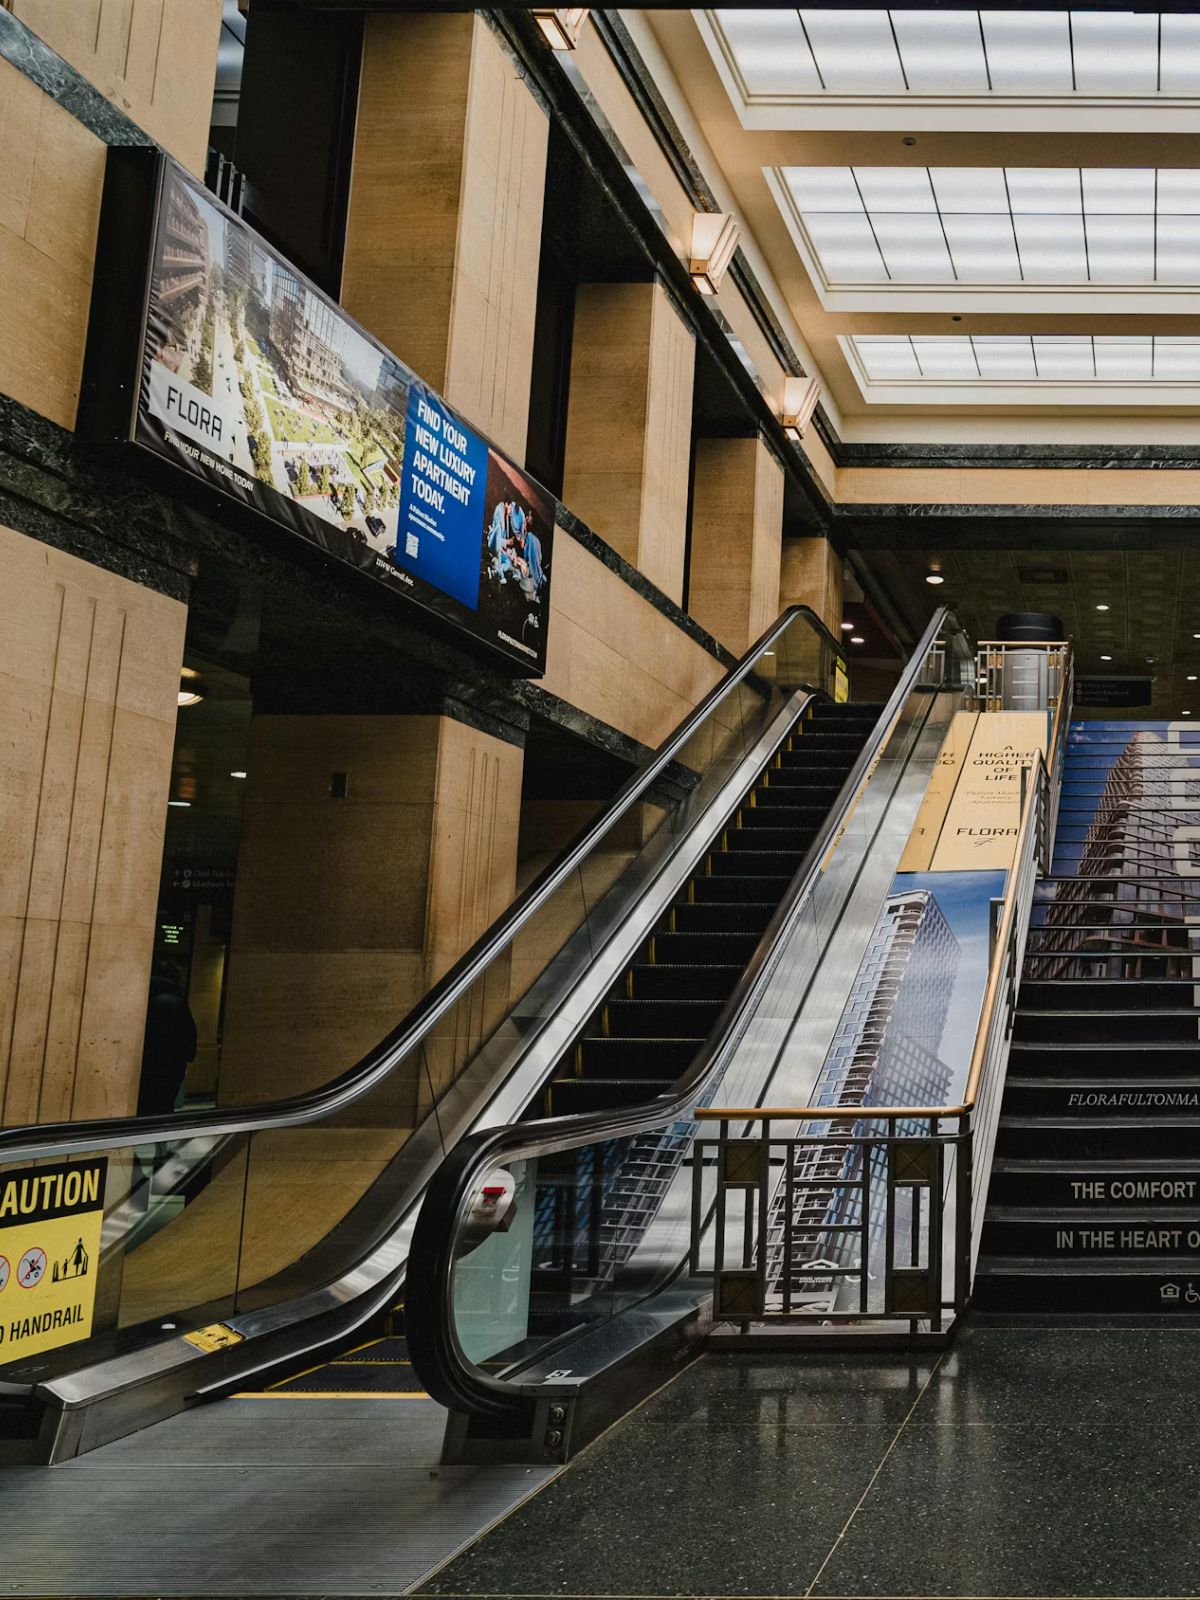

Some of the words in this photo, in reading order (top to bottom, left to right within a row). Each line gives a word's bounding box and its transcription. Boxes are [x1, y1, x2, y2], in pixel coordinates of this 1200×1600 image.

[166, 385, 223, 441] FLORA
[418, 399, 441, 432] FIND
[442, 419, 467, 456] YOUR
[164, 431, 180, 450] FIND
[179, 442, 200, 460] YOUR
[200, 452, 215, 469] NEW
[216, 461, 234, 480] HOME
[233, 471, 254, 492] TODAY
[413, 450, 471, 506] APARTMENT
[415, 423, 439, 456] NEW
[440, 443, 476, 486] LUXURY
[411, 474, 445, 515] TODAY.
[956, 827, 1018, 836] FLORA
[0, 1168, 100, 1218] AUTION
[1071, 1182, 1105, 1199] THE
[1110, 1181, 1197, 1199] COMFORT
[1056, 1231, 1074, 1249] IN
[1079, 1231, 1115, 1249] THE
[1120, 1231, 1182, 1248] HEART
[10, 1304, 84, 1342] HANDRAIL
